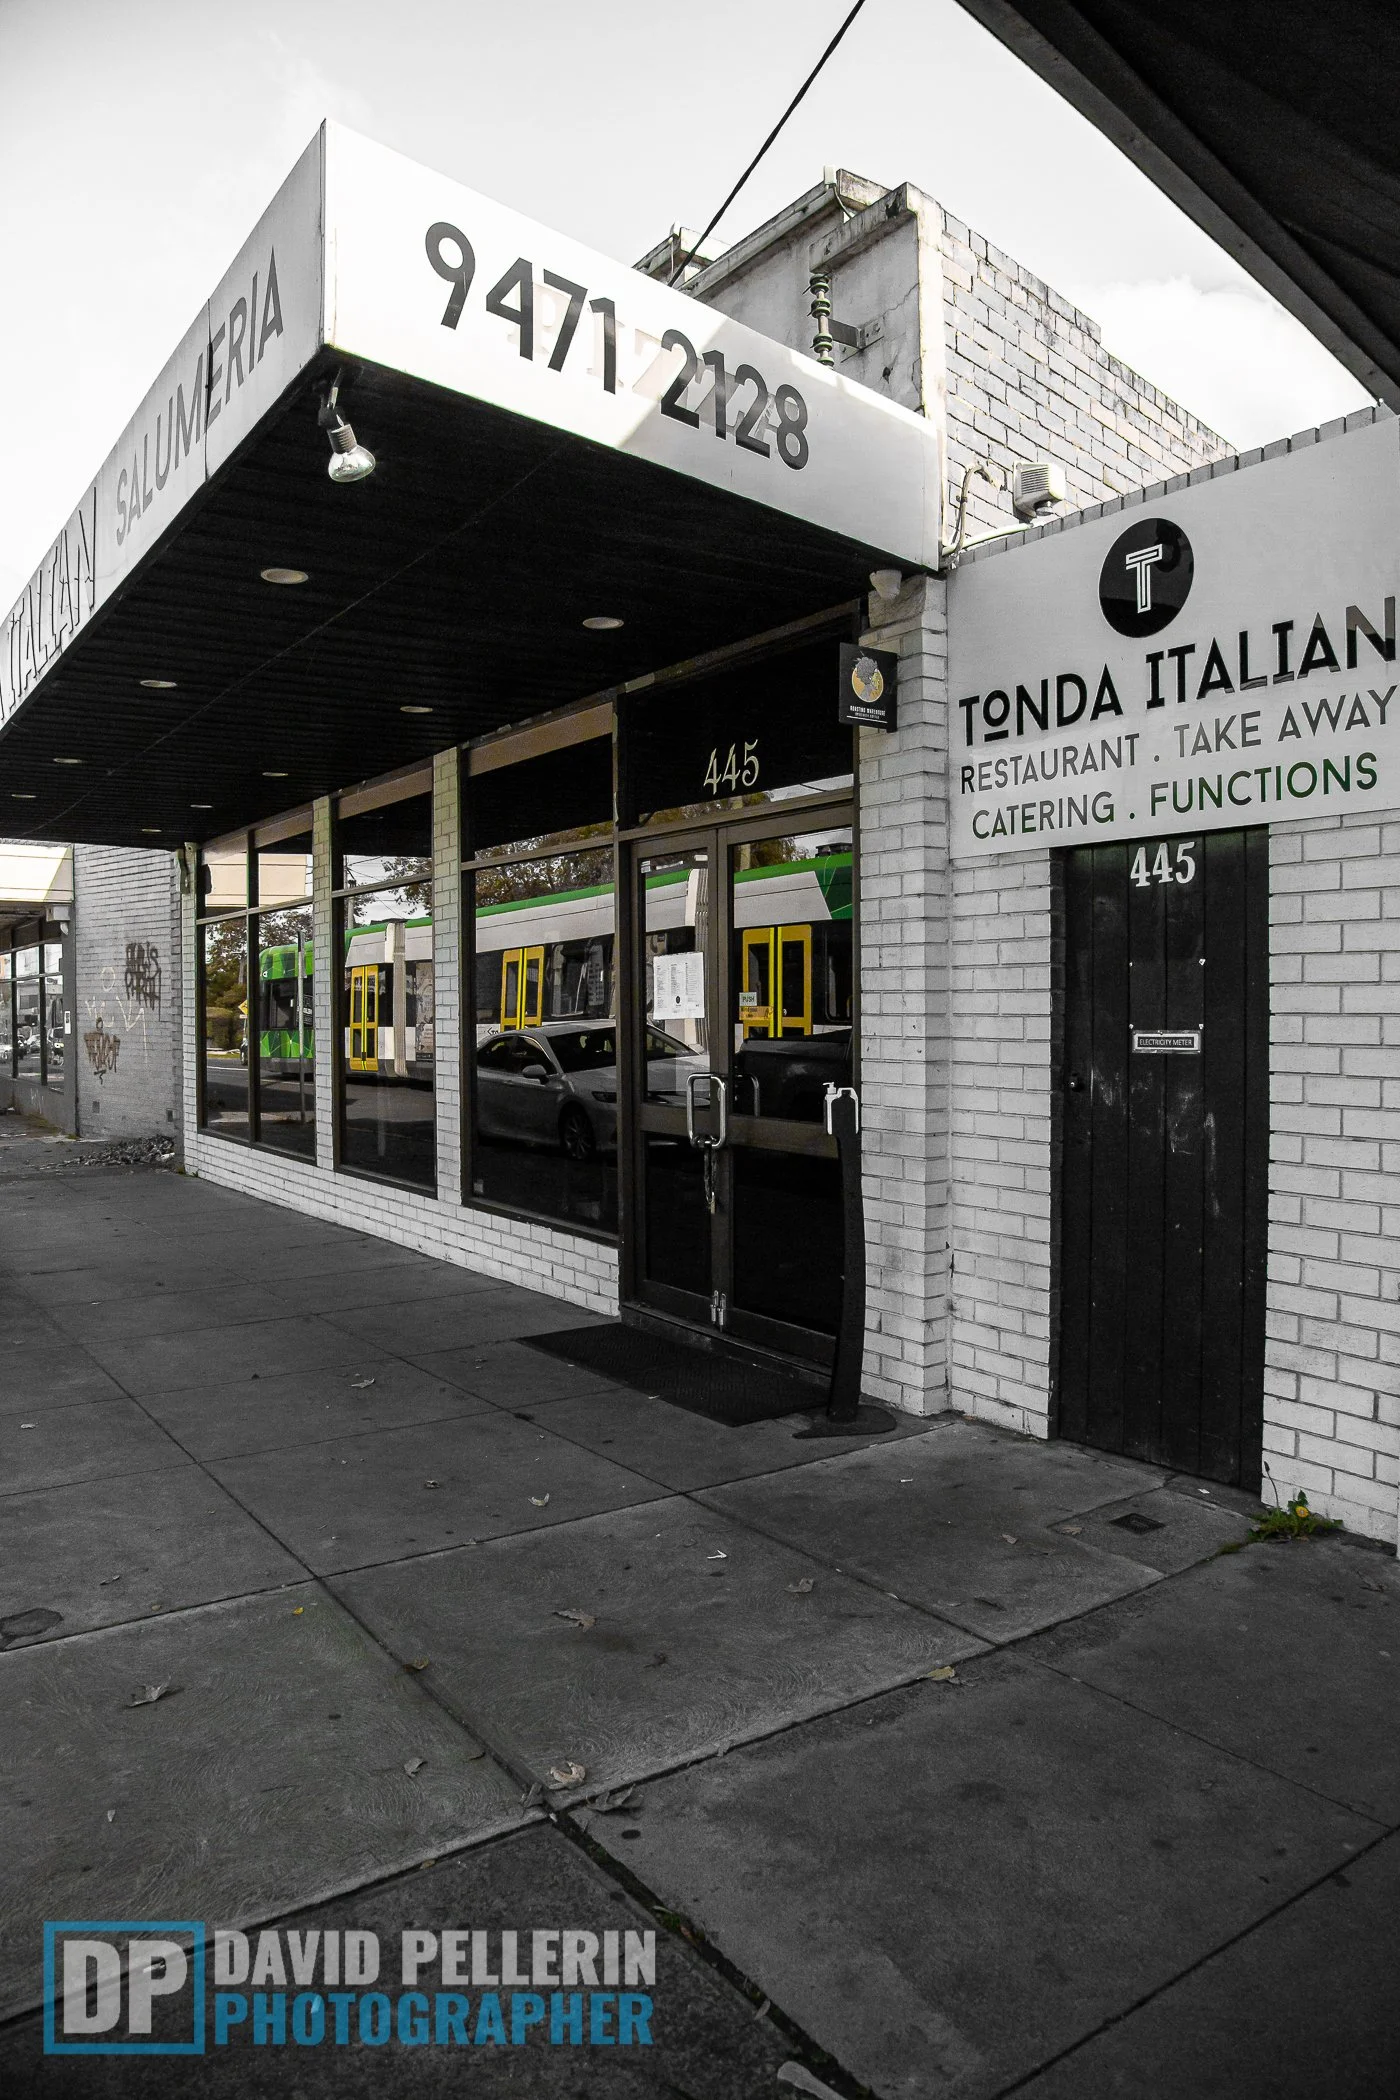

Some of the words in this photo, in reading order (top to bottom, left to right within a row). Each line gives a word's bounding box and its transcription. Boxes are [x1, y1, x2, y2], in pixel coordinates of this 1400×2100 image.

[425, 221, 617, 395] 9471
[660, 328, 810, 471] 2128
[116, 244, 284, 546] SALUMERIA
[1125, 543, 1163, 614] T
[958, 663, 1124, 747] TONDA
[1145, 595, 1397, 710] ITALIAN
[703, 738, 760, 796] 445
[961, 732, 1140, 795] RESTAURANT
[1173, 710, 1262, 758] TAKE
[1277, 684, 1398, 742] AWAY
[972, 791, 1115, 839] CATERING
[1150, 751, 1378, 817] FUNCTIONS
[1130, 841, 1196, 888] 445
[1139, 1038, 1172, 1046] ELECTRICITY
[1172, 1038, 1193, 1046] METER
